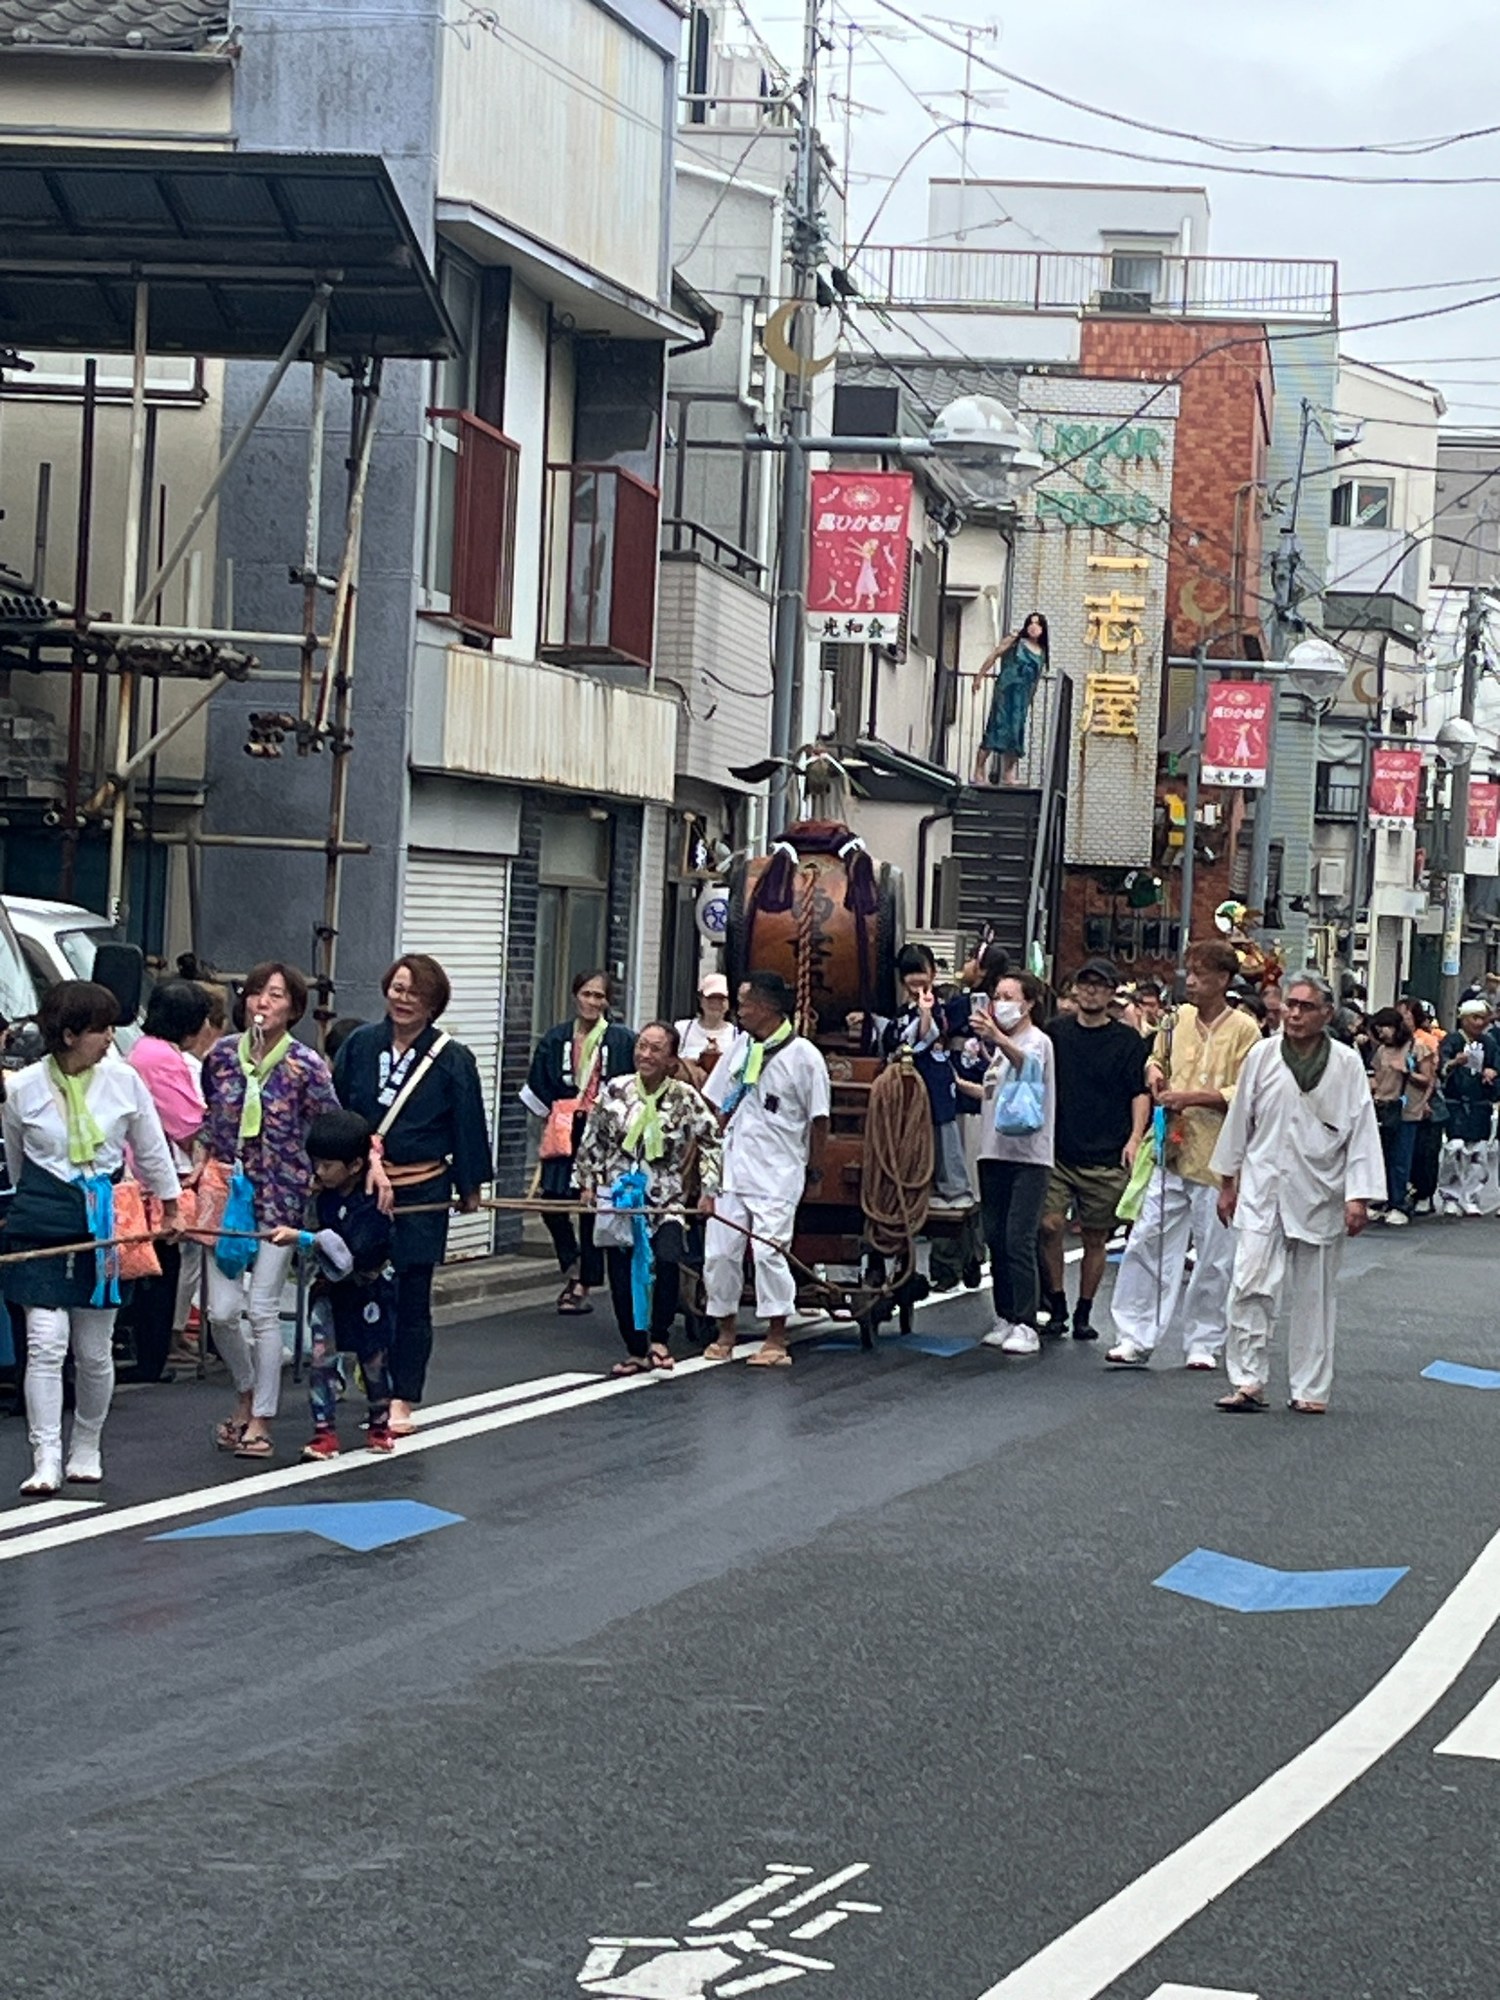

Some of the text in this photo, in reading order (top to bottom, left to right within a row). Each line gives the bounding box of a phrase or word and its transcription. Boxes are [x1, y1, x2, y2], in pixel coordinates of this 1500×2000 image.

[822, 616, 884, 639] 光和会
[1079, 556, 1149, 736] 一志屋
